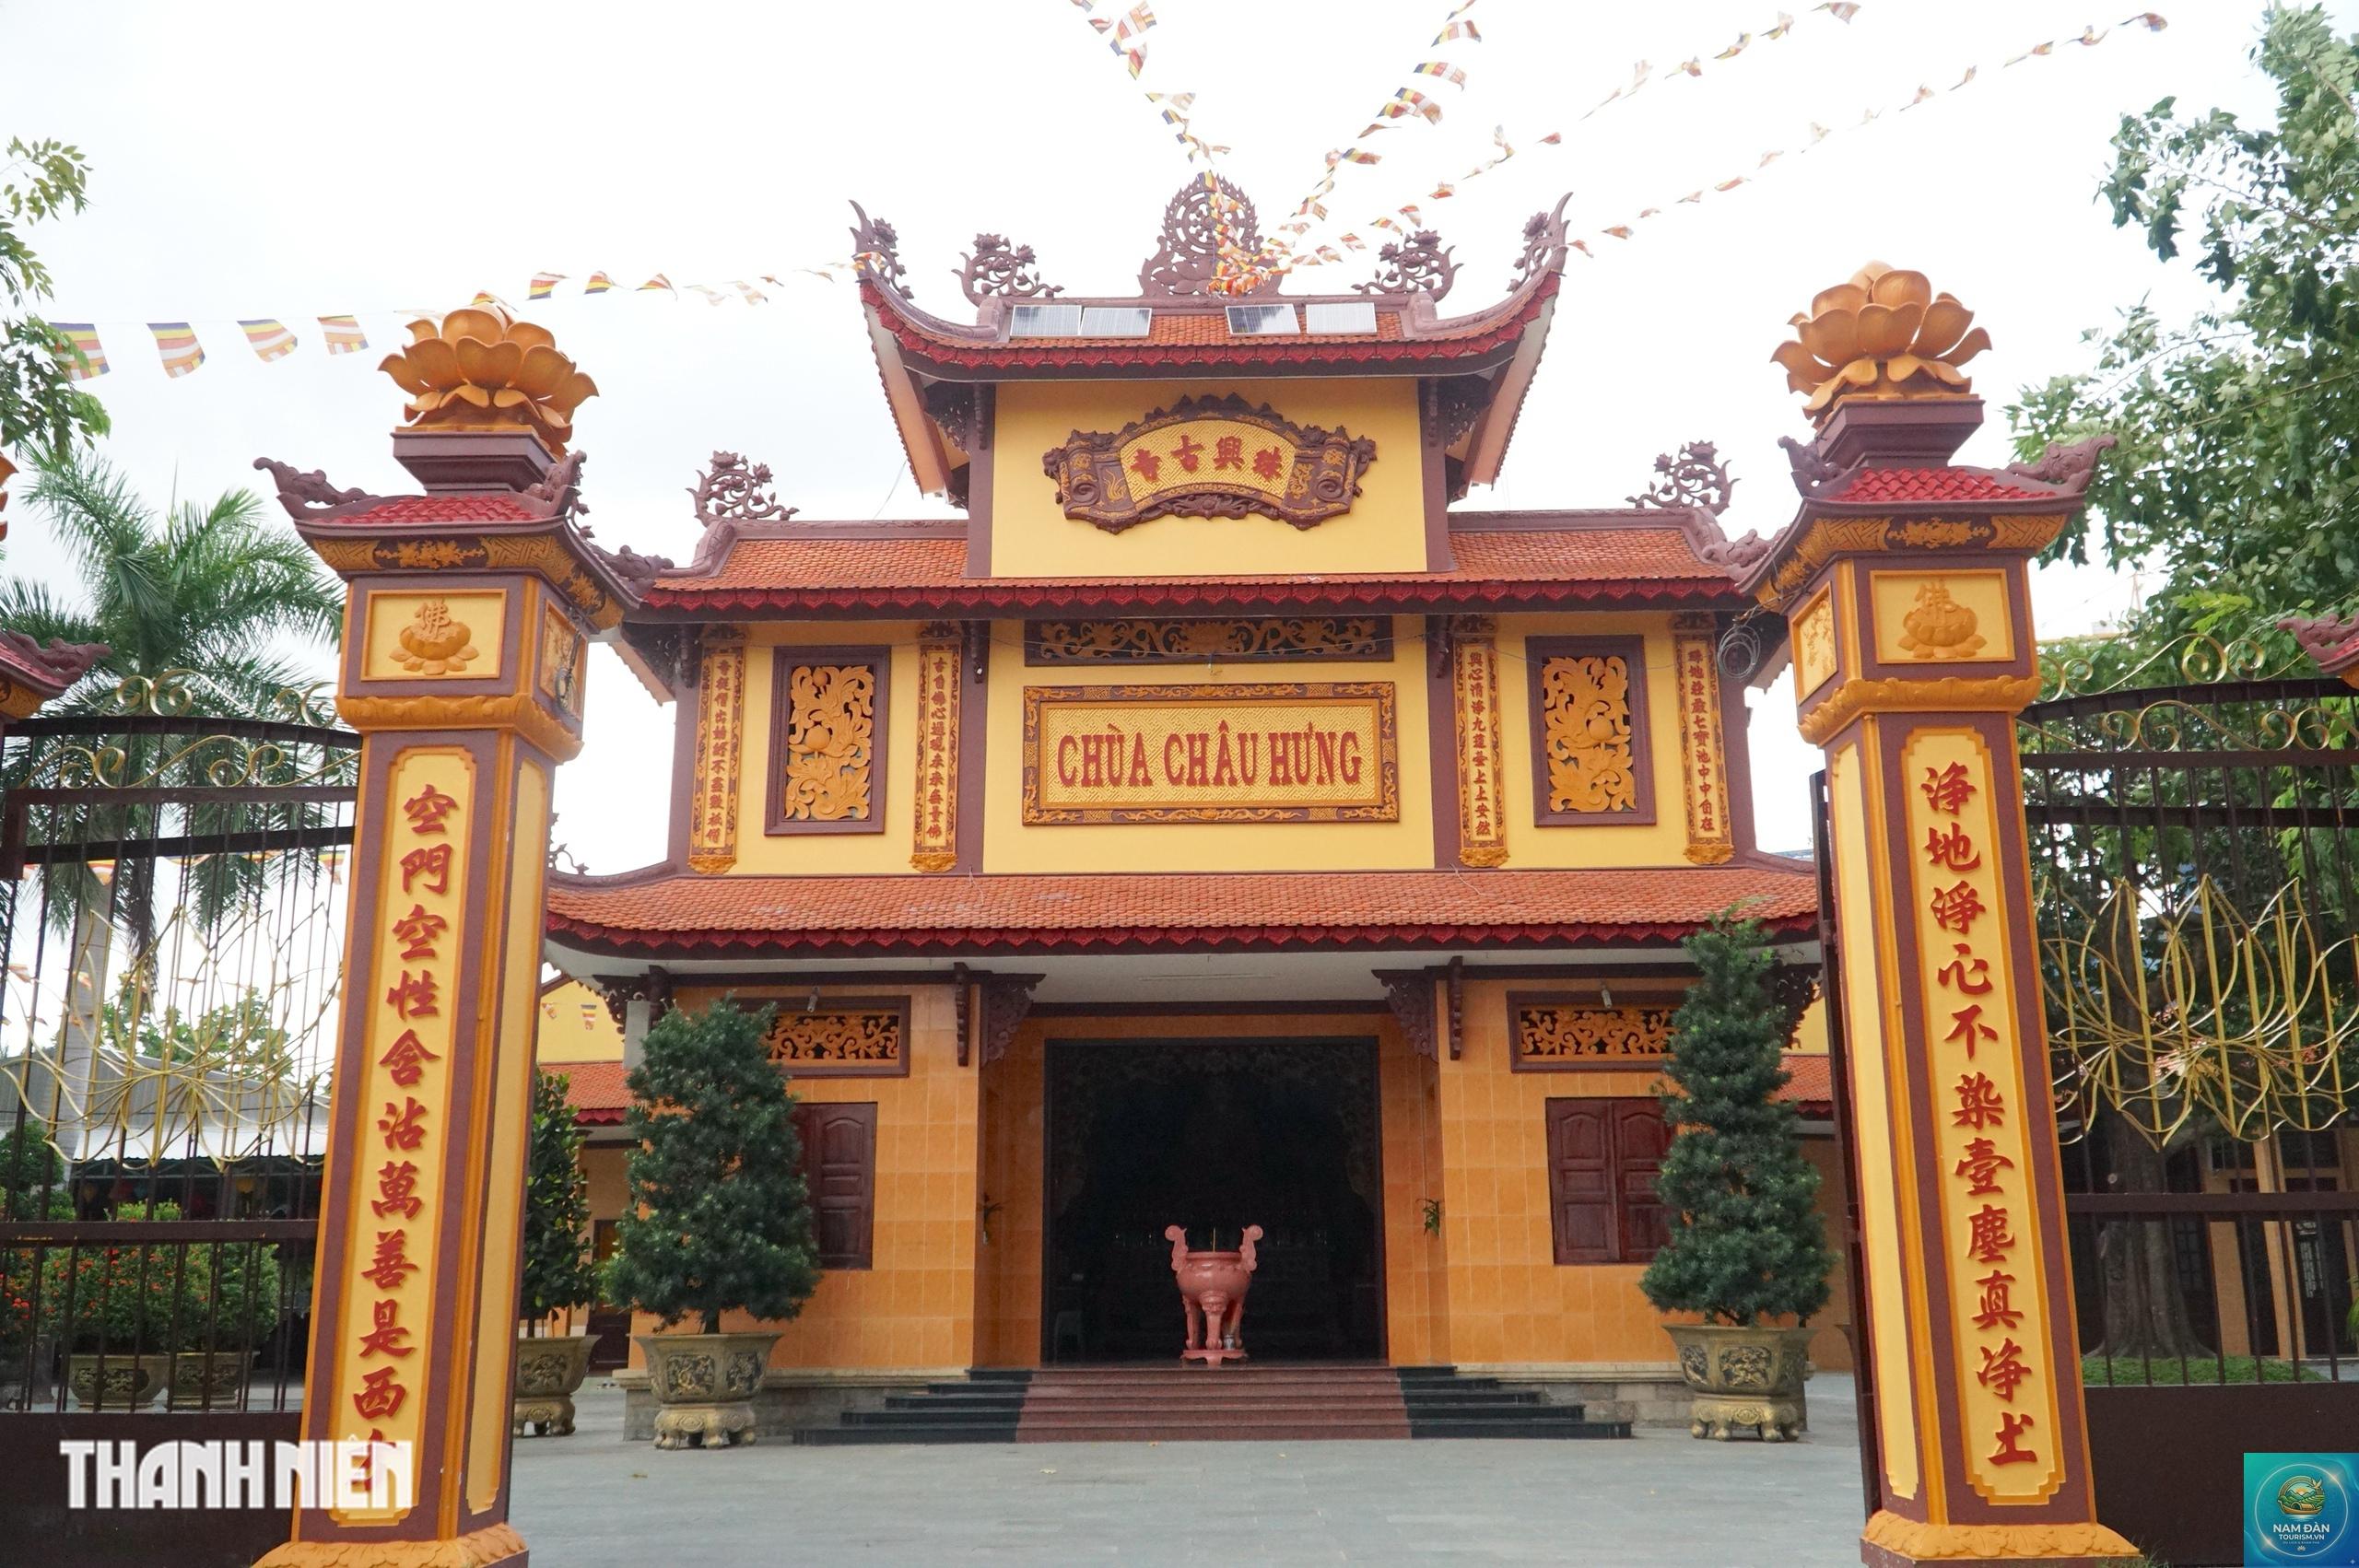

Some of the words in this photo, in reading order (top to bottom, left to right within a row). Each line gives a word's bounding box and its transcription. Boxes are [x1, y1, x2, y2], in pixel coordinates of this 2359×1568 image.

[414, 597, 452, 639] 佛
[1057, 722, 1152, 789] CHÙA
[1163, 720, 1259, 788] CHÂU
[1267, 720, 1362, 786] HƯNG
